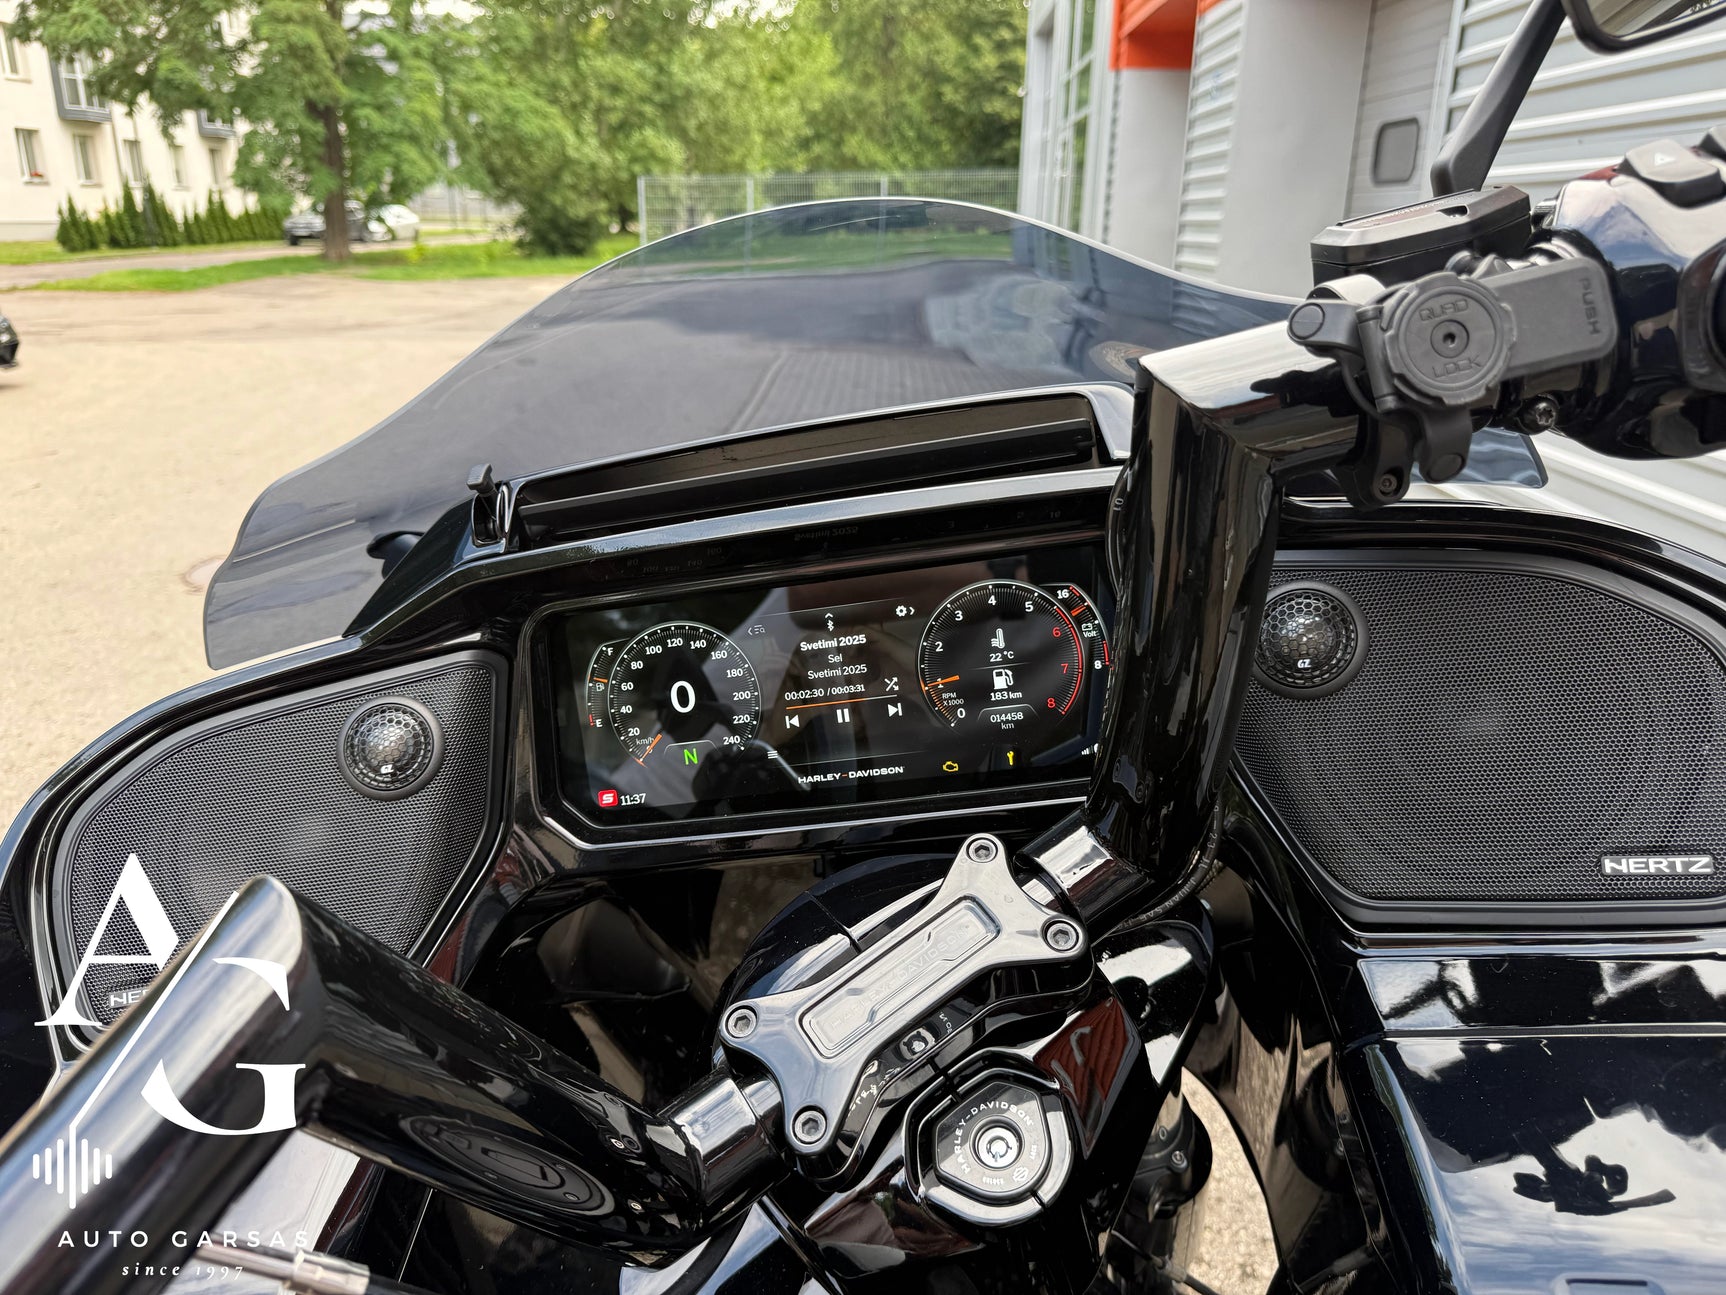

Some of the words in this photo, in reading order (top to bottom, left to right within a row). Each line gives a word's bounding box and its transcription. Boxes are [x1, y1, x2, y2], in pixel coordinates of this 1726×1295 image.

[1419, 299, 1469, 322] QUAD
[1578, 277, 1601, 335] PUSH
[1432, 355, 1482, 378] LOCK
[1057, 589, 1070, 599] 16
[988, 595, 996, 606] 4
[1025, 602, 1034, 612] 5
[955, 610, 963, 621] 3
[1052, 627, 1061, 637] 6
[667, 637, 683, 647] 120
[690, 639, 706, 649] 140
[800, 638, 838, 651] Svetimi
[840, 635, 866, 646] 2025
[935, 642, 943, 652] 2
[607, 648, 613, 656] F
[645, 645, 662, 655] 100
[711, 650, 727, 660] 160
[828, 654, 843, 663] Sel
[990, 653, 1002, 662] 22
[631, 660, 643, 670] 80
[1061, 664, 1069, 674] 7
[1094, 661, 1102, 670] 8
[726, 668, 743, 677] 180
[808, 667, 842, 679] Svetimi
[843, 664, 867, 675] 2025
[621, 682, 634, 692] 60
[670, 680, 696, 714] 0
[733, 690, 750, 700] 200
[784, 689, 825, 701] 00:02:30
[831, 684, 865, 695] 00:03:31
[990, 692, 1008, 701] 183
[1009, 691, 1022, 699] km
[1048, 698, 1056, 708] 8
[620, 705, 632, 714] 40
[957, 709, 965, 719] 0
[733, 714, 750, 724] 220
[990, 712, 1024, 723] 014458
[596, 719, 602, 727] E
[1001, 722, 1014, 730] km
[628, 727, 640, 737] 20
[723, 735, 740, 745] 240
[684, 748, 698, 766] N
[798, 766, 904, 784] HARLEY-DAVIDSON
[620, 793, 646, 805] 11:37
[1604, 857, 1712, 873] HERTZ
